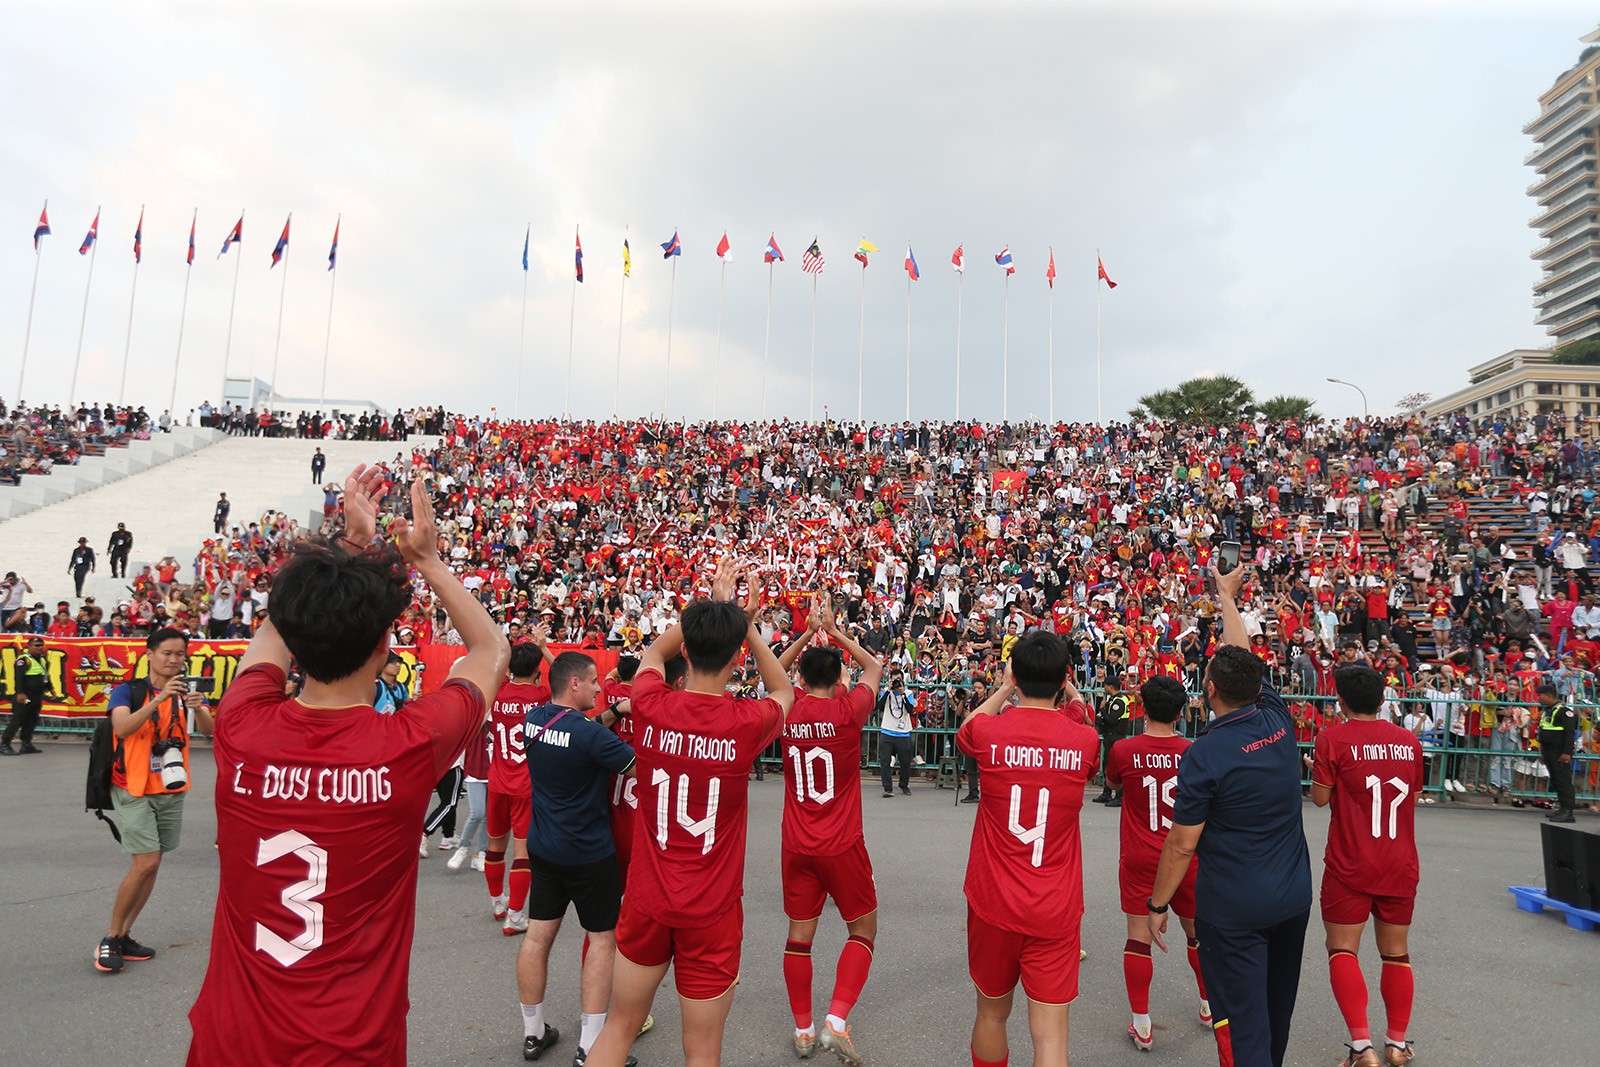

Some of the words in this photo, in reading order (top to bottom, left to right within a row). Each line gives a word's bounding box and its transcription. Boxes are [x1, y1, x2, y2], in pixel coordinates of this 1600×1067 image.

[502, 702, 519, 714] QUOC
[642, 725, 653, 748] N.
[660, 729, 683, 755] VAN
[688, 734, 736, 762] TRUONG
[790, 723, 813, 739] XUAN
[814, 722, 836, 738] TIEN
[1241, 727, 1287, 753] VIETNAM
[990, 744, 1000, 765] T.
[1004, 745, 1043, 768] QUANG
[1048, 747, 1082, 771] THINH
[1133, 753, 1143, 769] H.
[1146, 753, 1172, 769] CONG
[1350, 745, 1361, 761] V.
[1363, 744, 1387, 760] MINH
[1388, 743, 1415, 761] TRONG
[234, 762, 252, 795] L.
[263, 765, 312, 801] DUY
[318, 766, 392, 803] CUONG
[788, 745, 835, 805] 10
[651, 768, 721, 856] 14
[1365, 774, 1410, 840] 17
[1008, 784, 1050, 868] 4
[255, 829, 328, 967] 3
